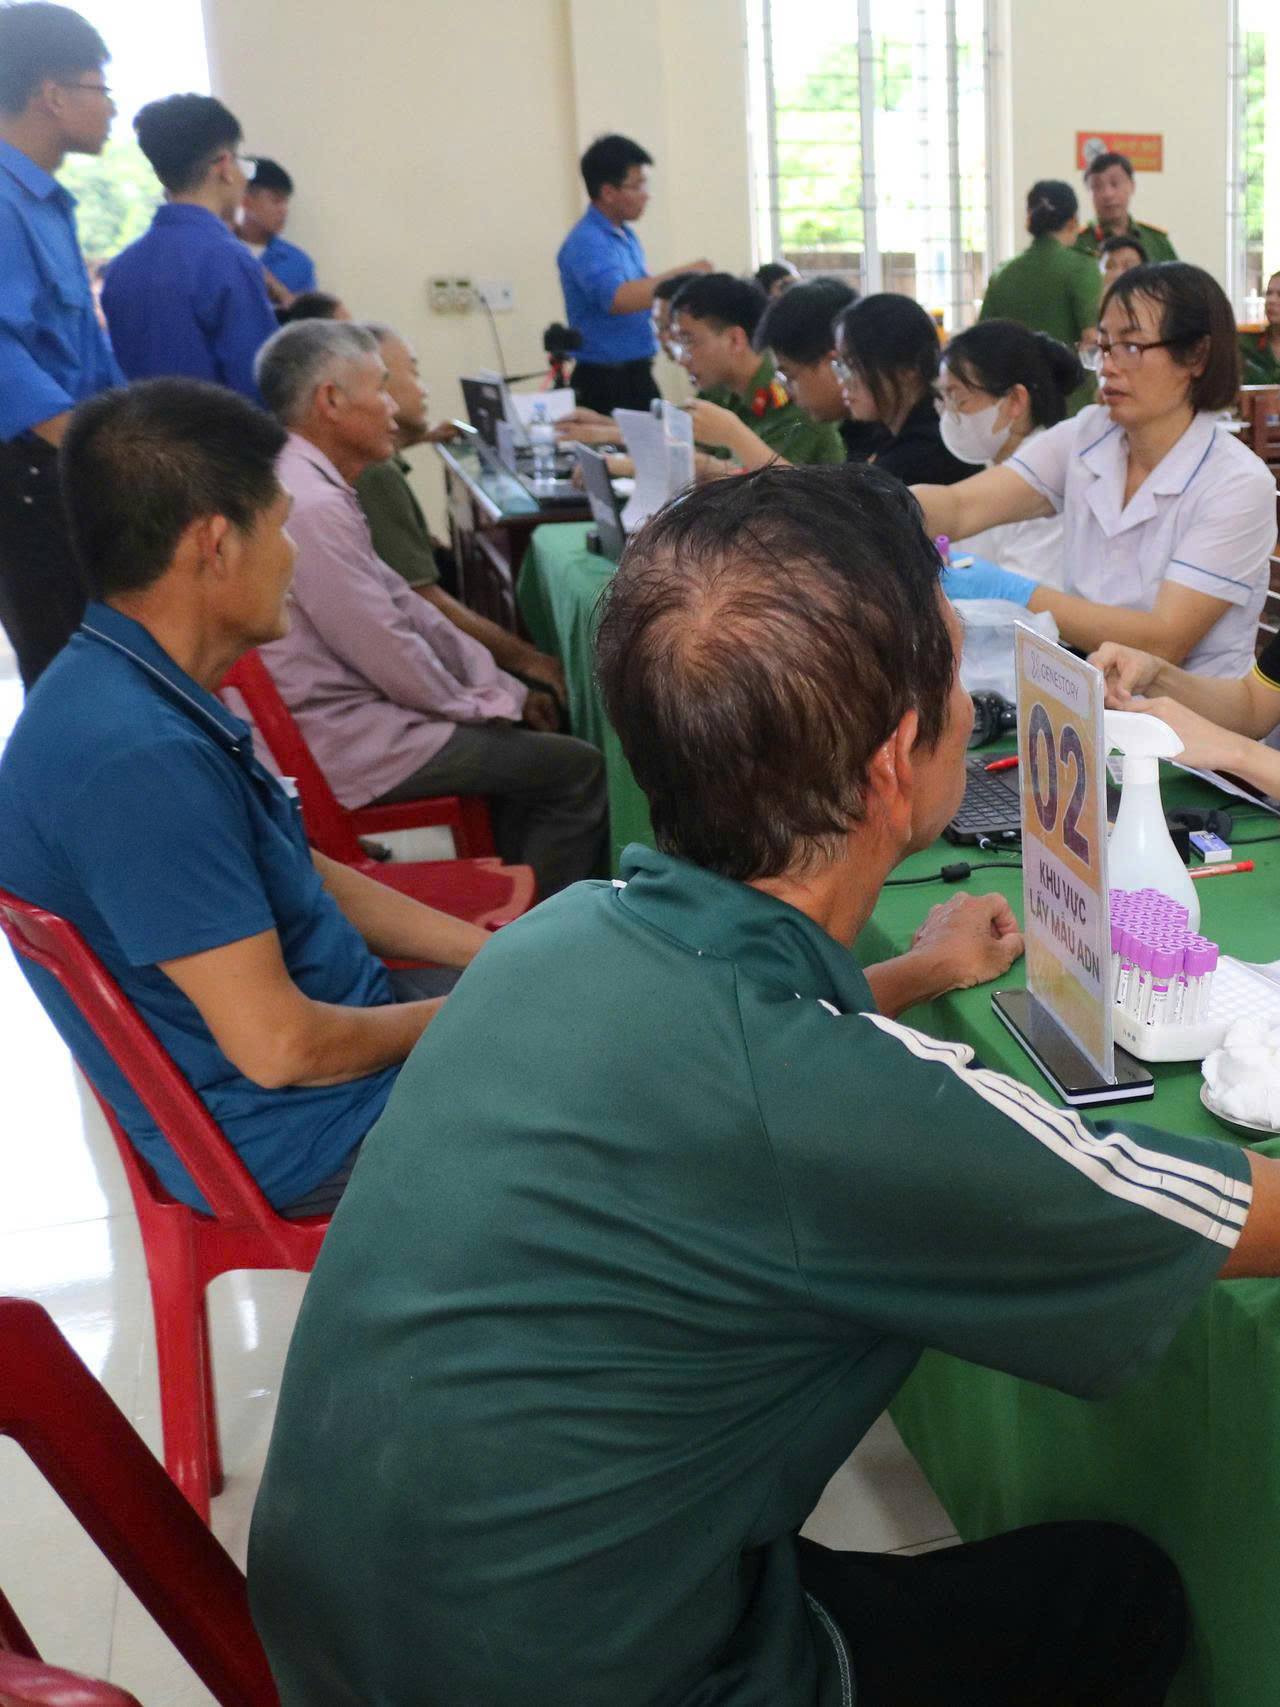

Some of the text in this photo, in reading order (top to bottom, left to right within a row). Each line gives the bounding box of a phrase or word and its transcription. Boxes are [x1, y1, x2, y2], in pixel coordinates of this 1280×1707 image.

[1041, 663, 1080, 701] GENESTORY
[1028, 703, 1090, 868] 02
[1040, 859, 1087, 925] KHU VỰC
[1030, 887, 1101, 983] LẤY MẪU ADN
